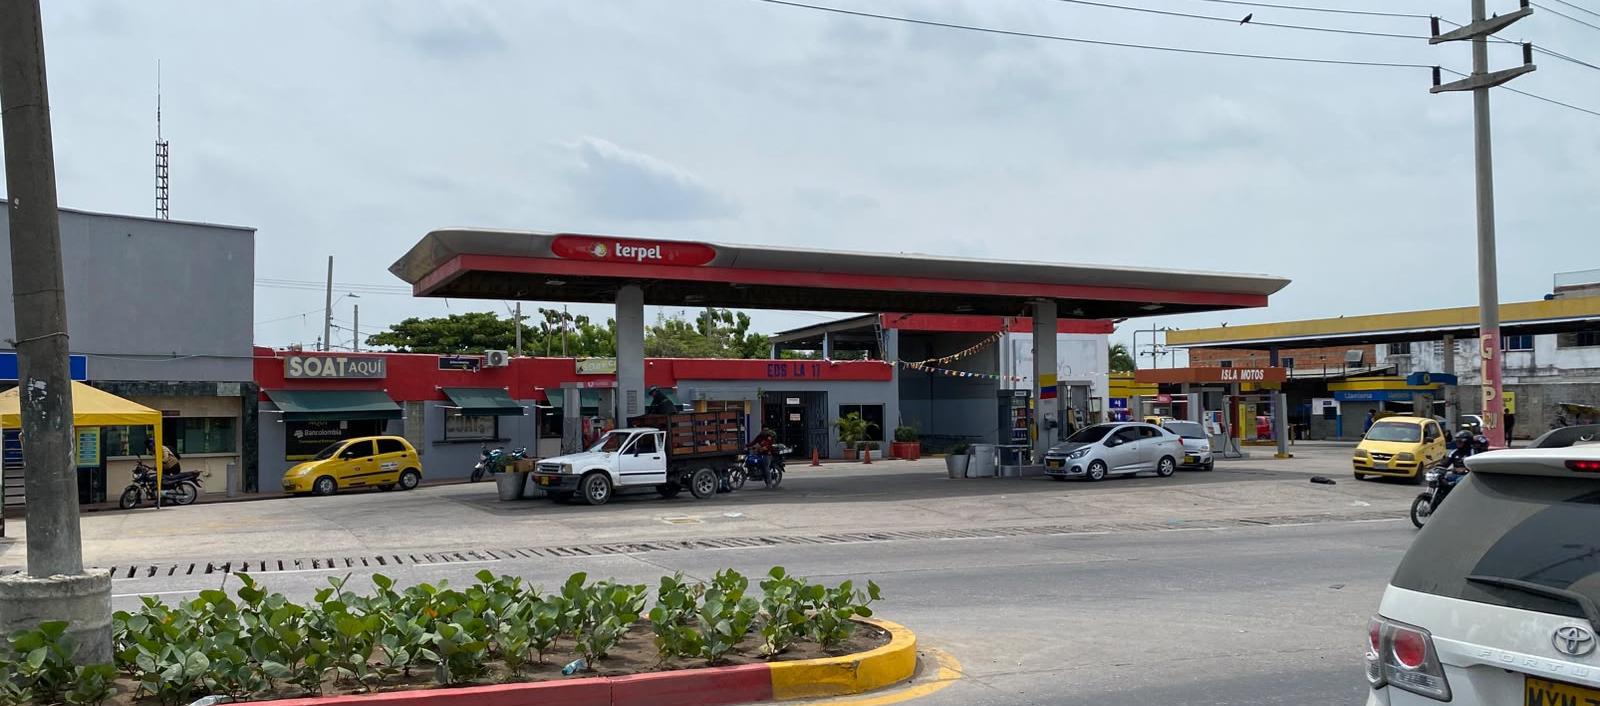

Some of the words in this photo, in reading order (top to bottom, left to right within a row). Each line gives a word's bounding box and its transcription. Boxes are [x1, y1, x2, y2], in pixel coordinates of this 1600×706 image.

[615, 243, 662, 262] terpel
[290, 356, 348, 377] SOAT
[348, 359, 382, 376] AQUÍ
[794, 362, 805, 377] LA
[1221, 369, 1238, 380] ISLA
[1241, 369, 1264, 380] MOTOS
